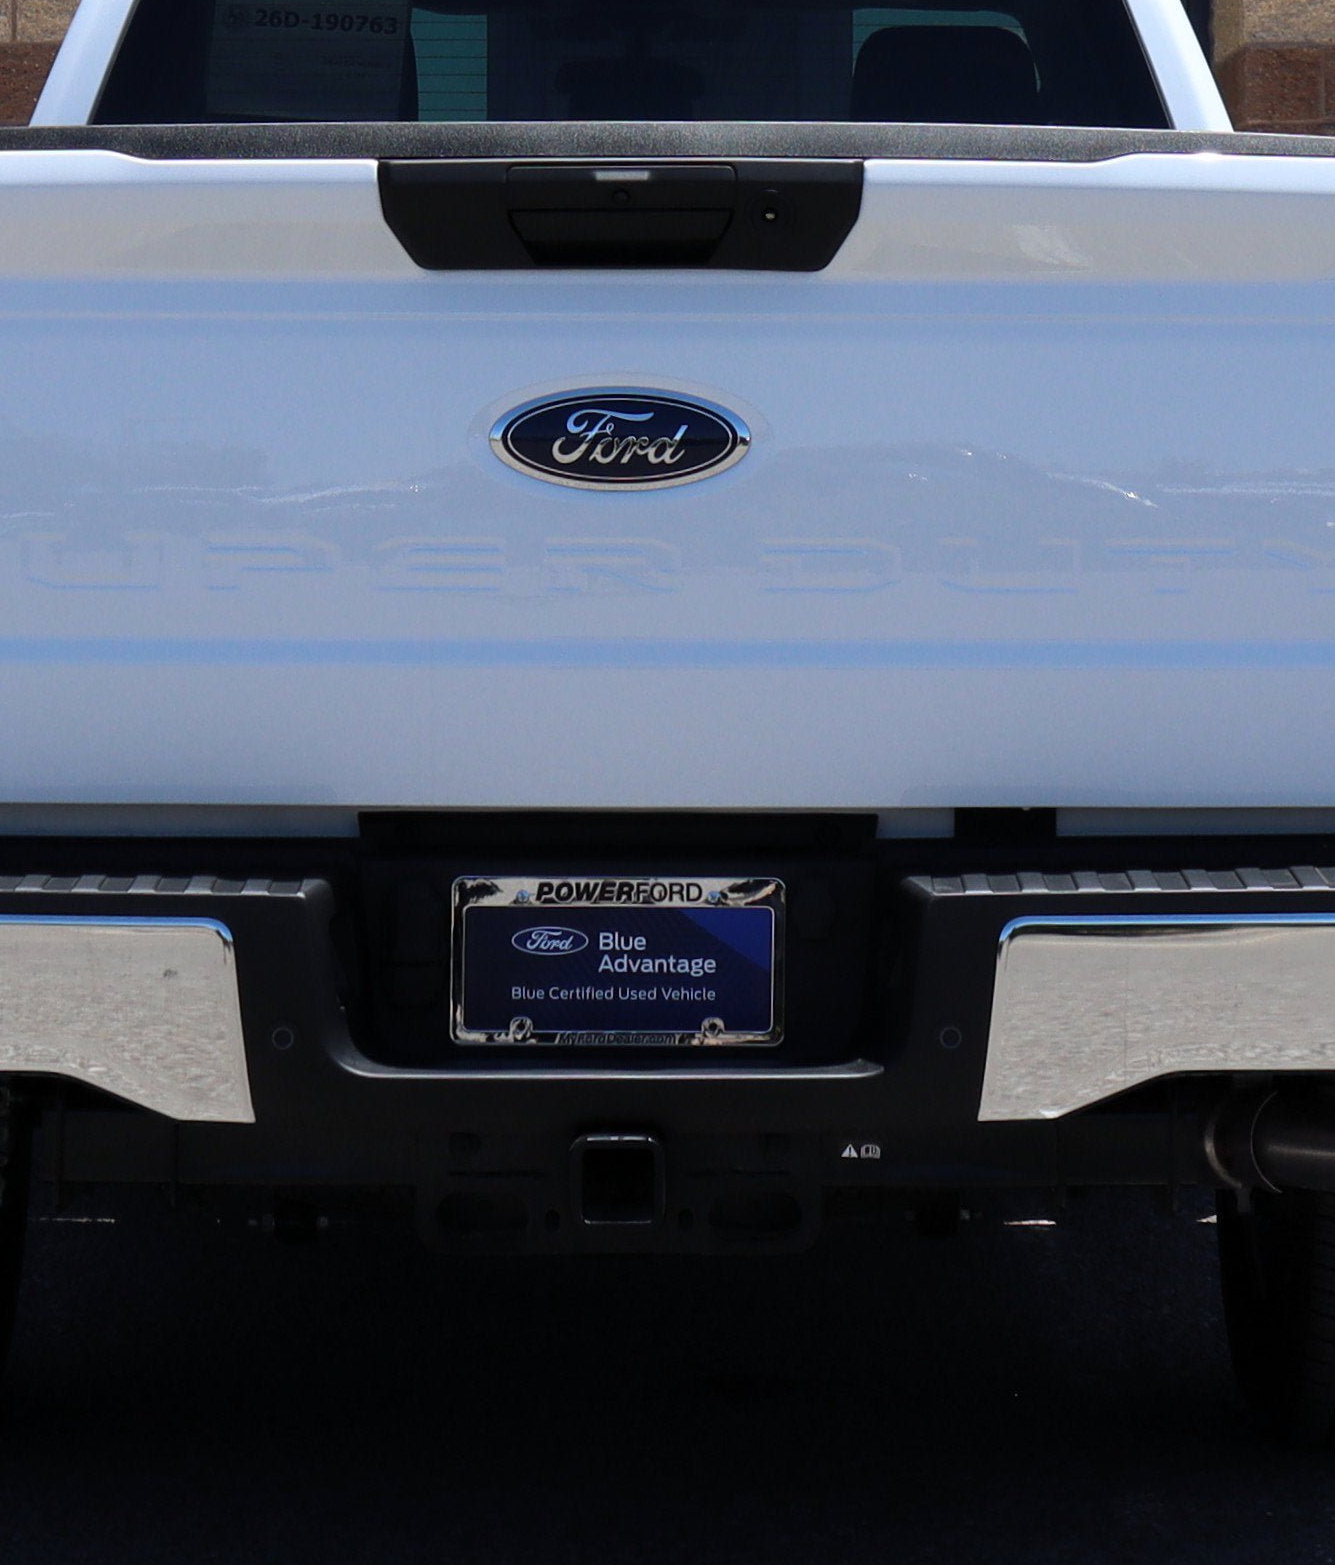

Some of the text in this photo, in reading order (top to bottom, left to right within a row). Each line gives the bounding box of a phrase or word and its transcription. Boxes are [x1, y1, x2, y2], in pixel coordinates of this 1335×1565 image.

[255, 8, 398, 35] 26D-190763
[552, 408, 689, 464] Ford
[535, 881, 703, 903] POWERFORD
[526, 929, 573, 951] Ford
[599, 932, 647, 951] Blue
[598, 954, 716, 977] Advantage
[511, 987, 716, 1001] Blue Certified Used Vehicle
